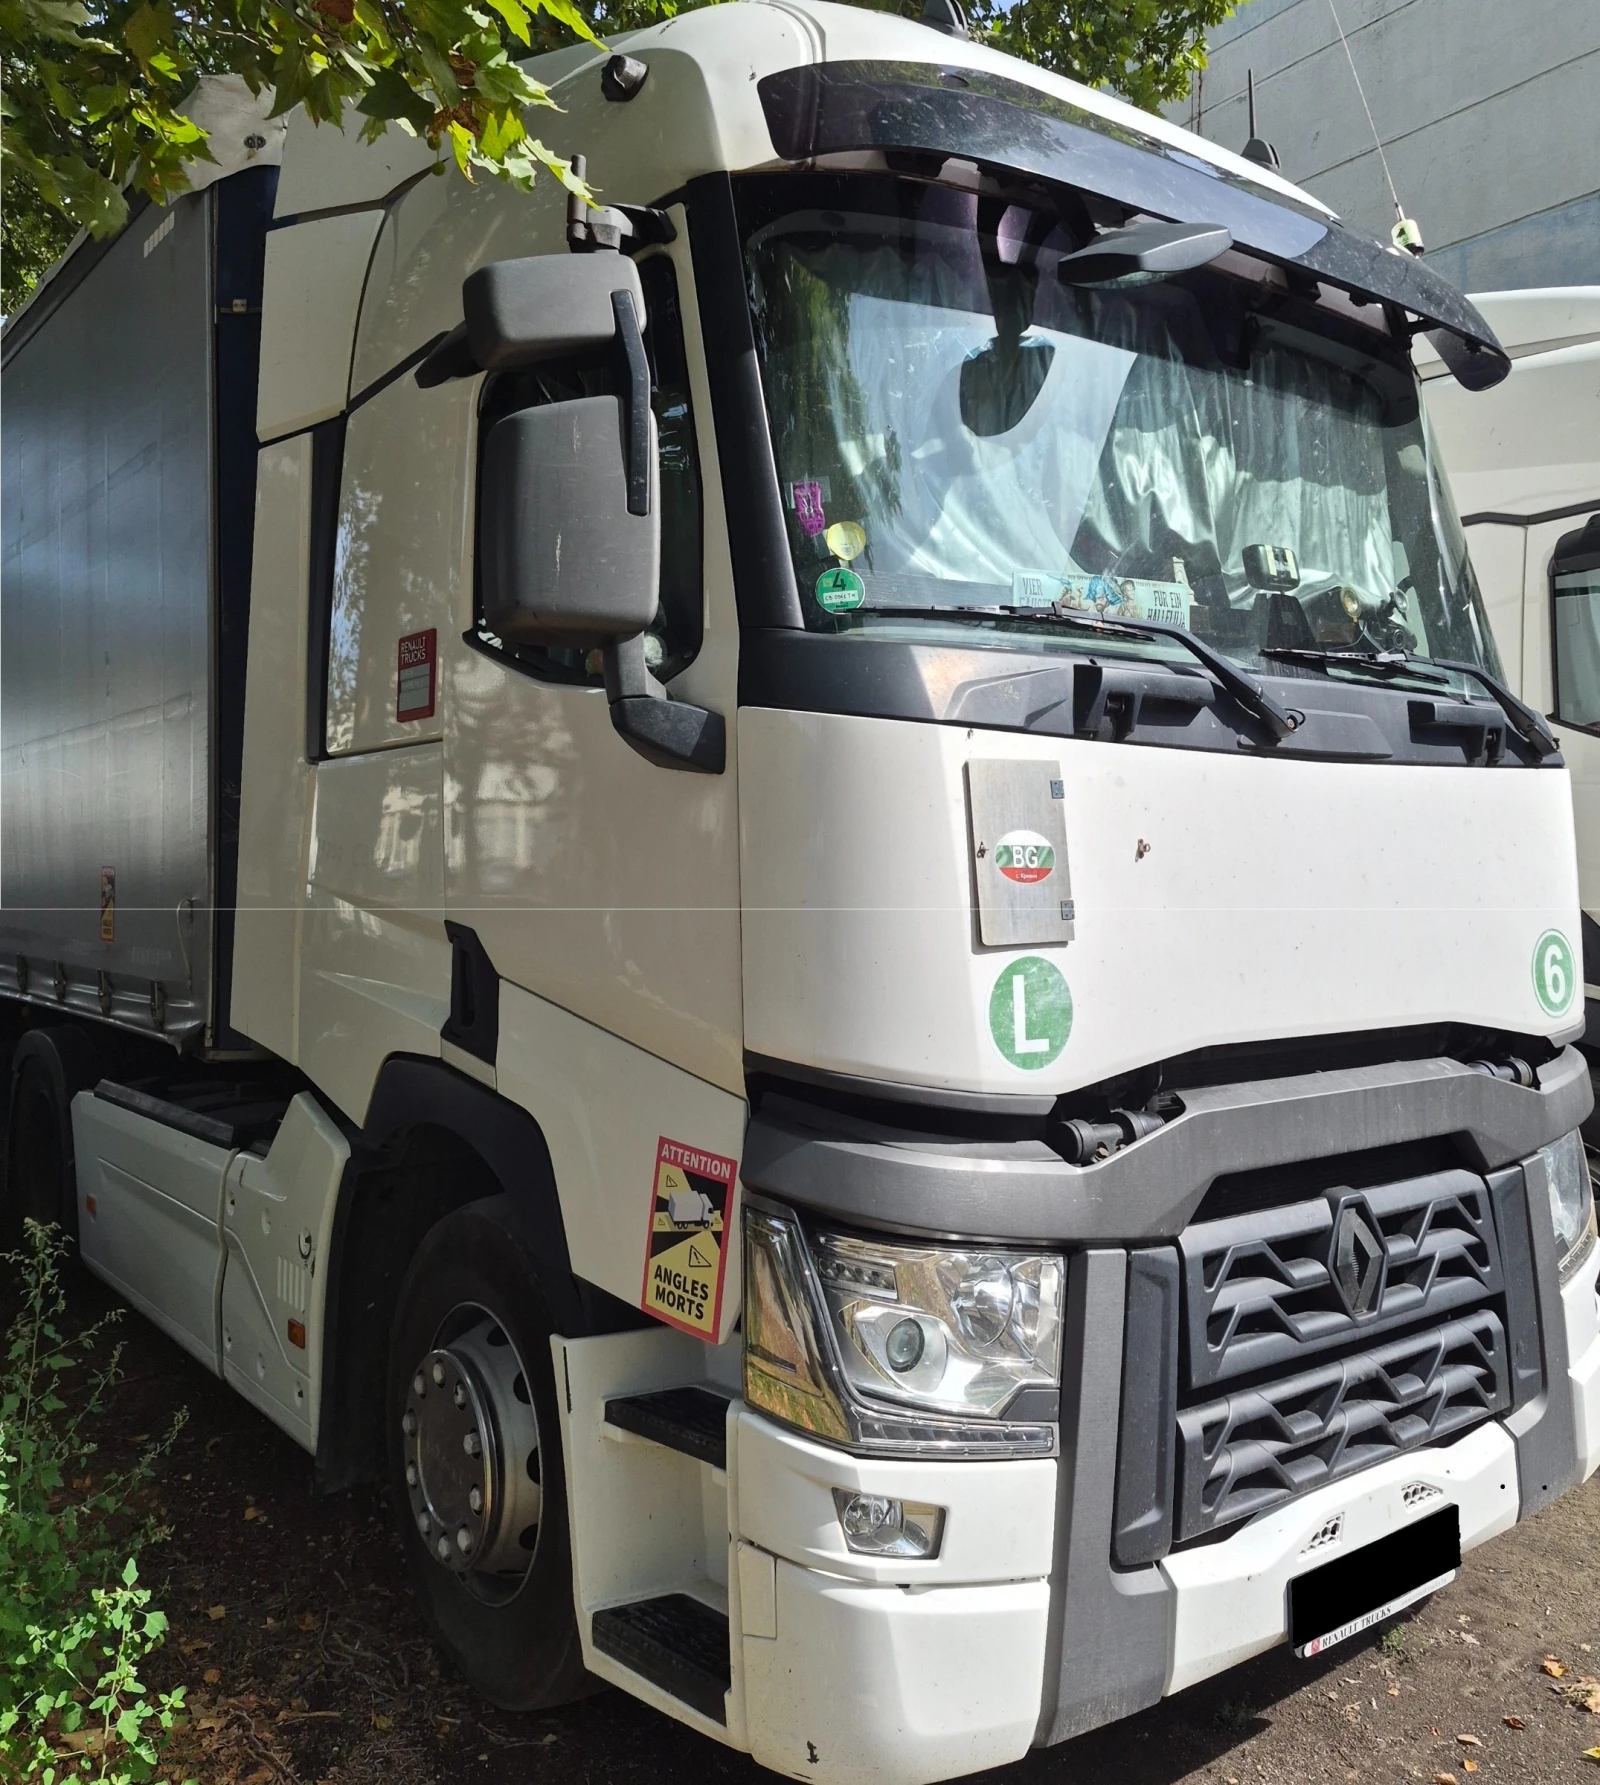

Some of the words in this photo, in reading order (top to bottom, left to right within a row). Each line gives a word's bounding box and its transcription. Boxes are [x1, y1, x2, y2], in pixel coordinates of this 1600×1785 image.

[830, 571, 847, 591] 4
[1022, 577, 1043, 596] VIER
[1153, 588, 1168, 608] FÜR
[1171, 591, 1183, 610] EIN
[401, 636, 426, 653] RENAULT
[401, 648, 426, 665] TRUCKS
[1012, 845, 1038, 869] BG
[1544, 944, 1566, 1004] 6
[1012, 974, 1050, 1055] L
[661, 1143, 731, 1179] ATTENTION
[654, 1264, 709, 1301] ANGLES
[655, 1284, 705, 1320] MORTS
[1322, 1621, 1360, 1648] RENAULT
[1361, 1605, 1392, 1629] TRUCKS
